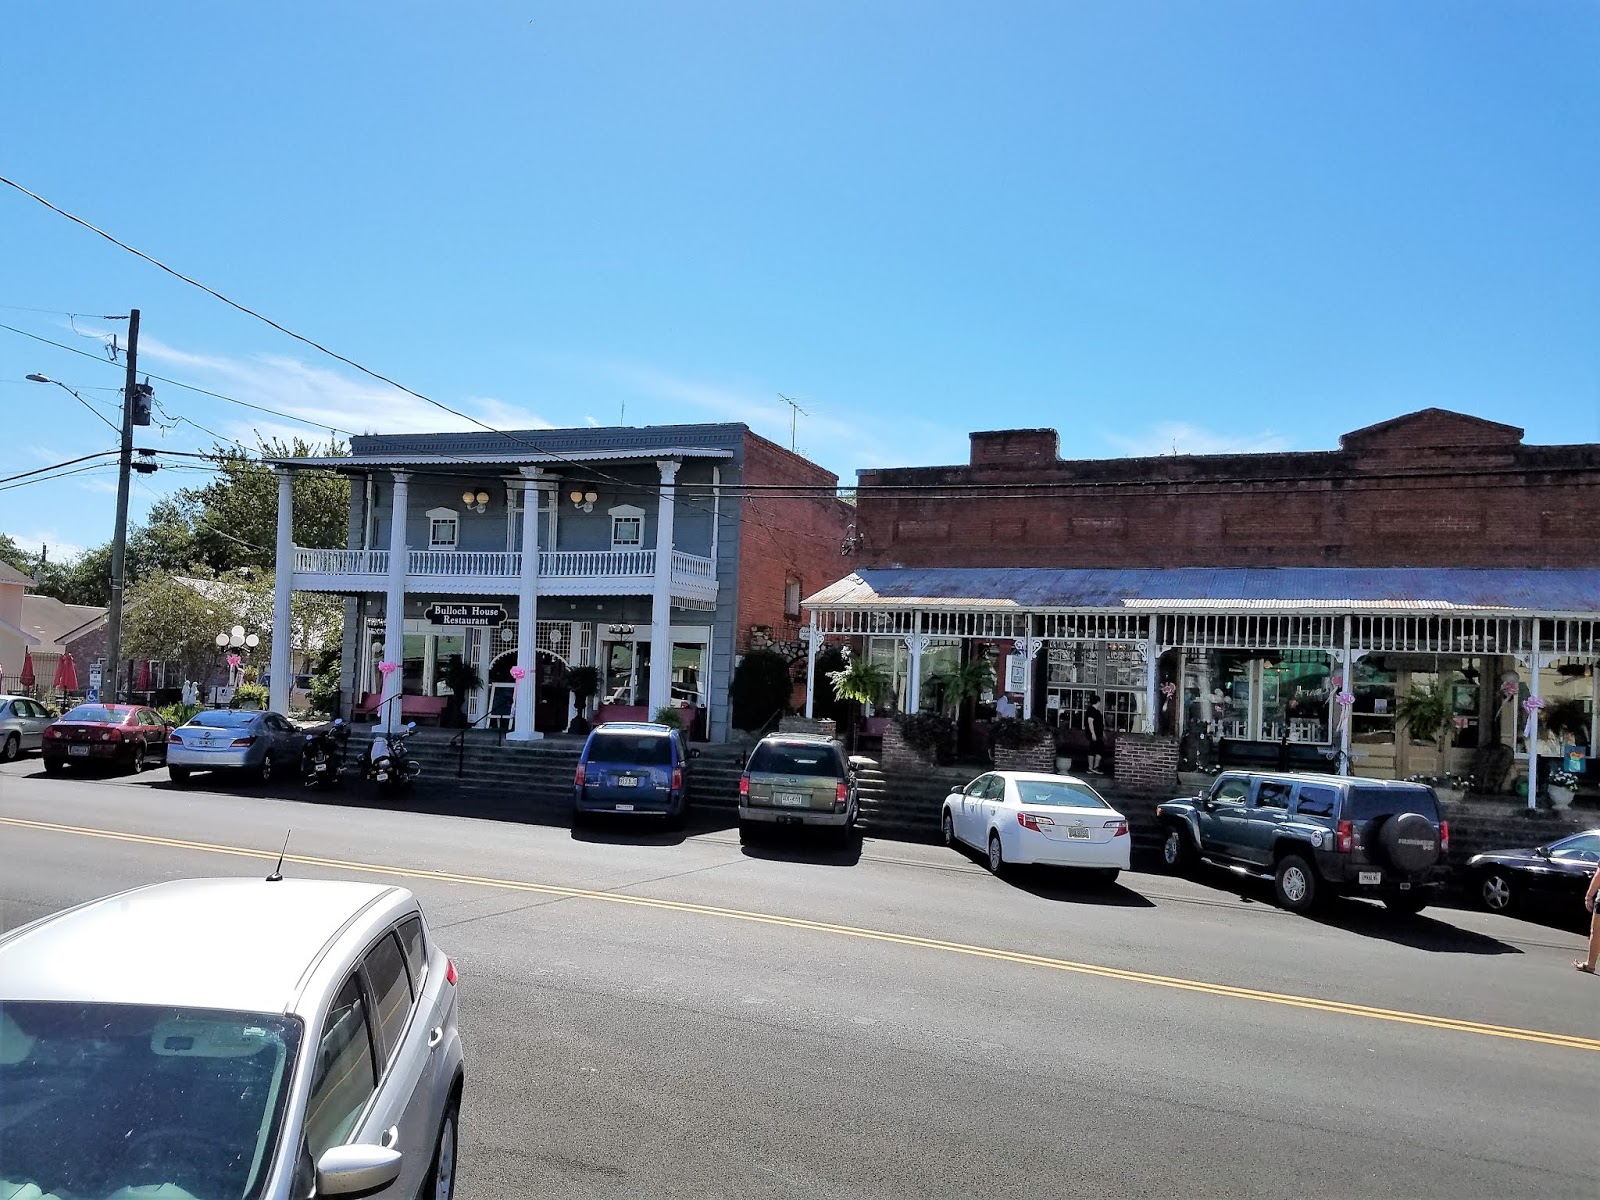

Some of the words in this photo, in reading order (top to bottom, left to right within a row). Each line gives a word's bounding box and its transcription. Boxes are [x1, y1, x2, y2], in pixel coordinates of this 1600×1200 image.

[434, 605, 467, 615] Bulloch
[472, 606, 499, 616] House
[443, 615, 489, 625] Restaurant
